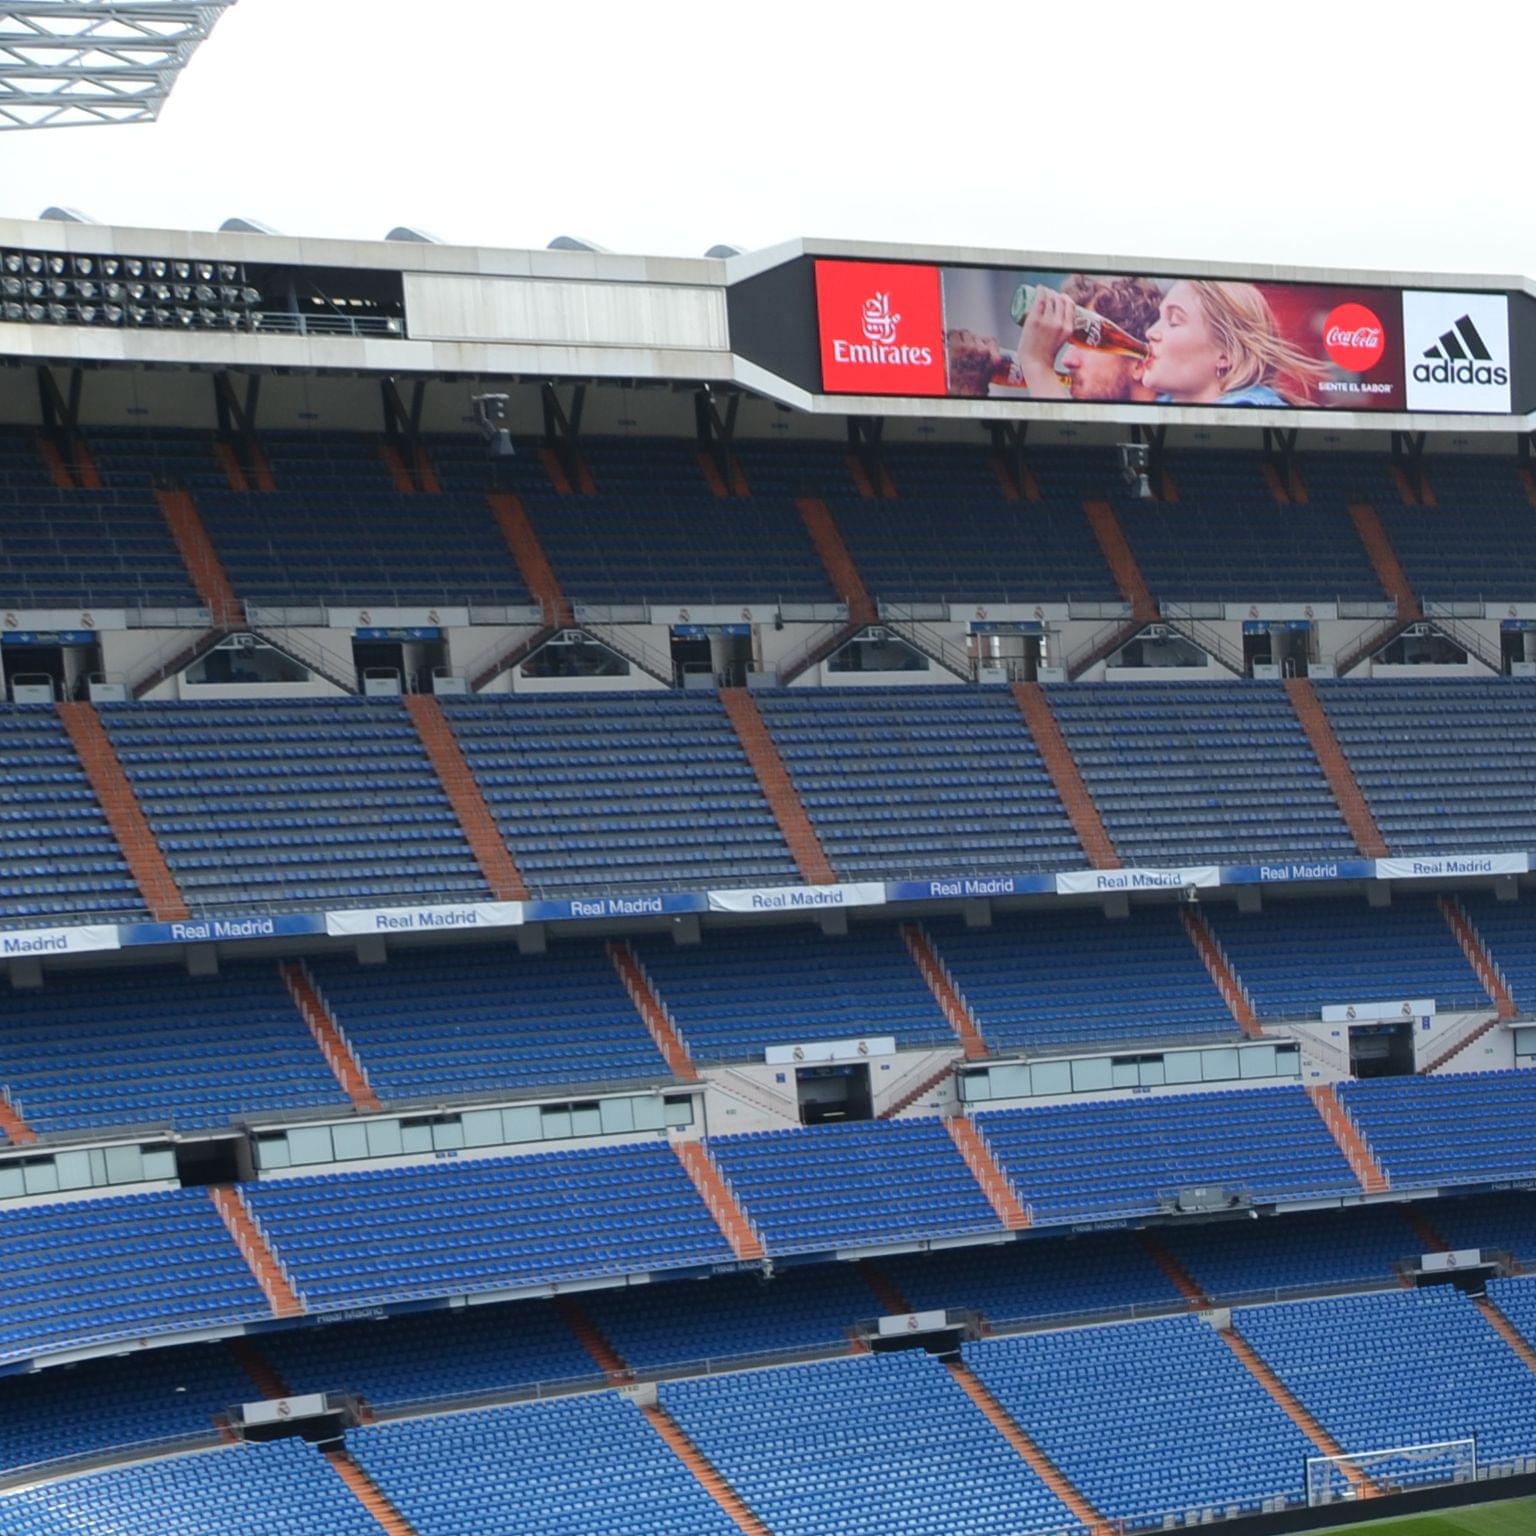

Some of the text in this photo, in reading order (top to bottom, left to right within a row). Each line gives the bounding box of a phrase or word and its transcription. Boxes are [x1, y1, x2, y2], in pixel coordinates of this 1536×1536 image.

[834, 339, 931, 365] Emirates
[1413, 358, 1508, 385] adidas
[1318, 382, 1347, 392] SIENTE
[1349, 384, 1360, 392] EL
[1260, 863, 1337, 880] Real Madrid
[1413, 861, 1491, 876] Real Madrid
[931, 878, 1013, 896] Real Madrid
[1097, 872, 1181, 888] Real Madrid
[571, 898, 661, 916] Real Madrid
[752, 891, 843, 908] Real Madrid
[376, 910, 476, 928] Real Madrid
[172, 919, 273, 940] Real Madrid
[4, 935, 67, 953] Madrid
